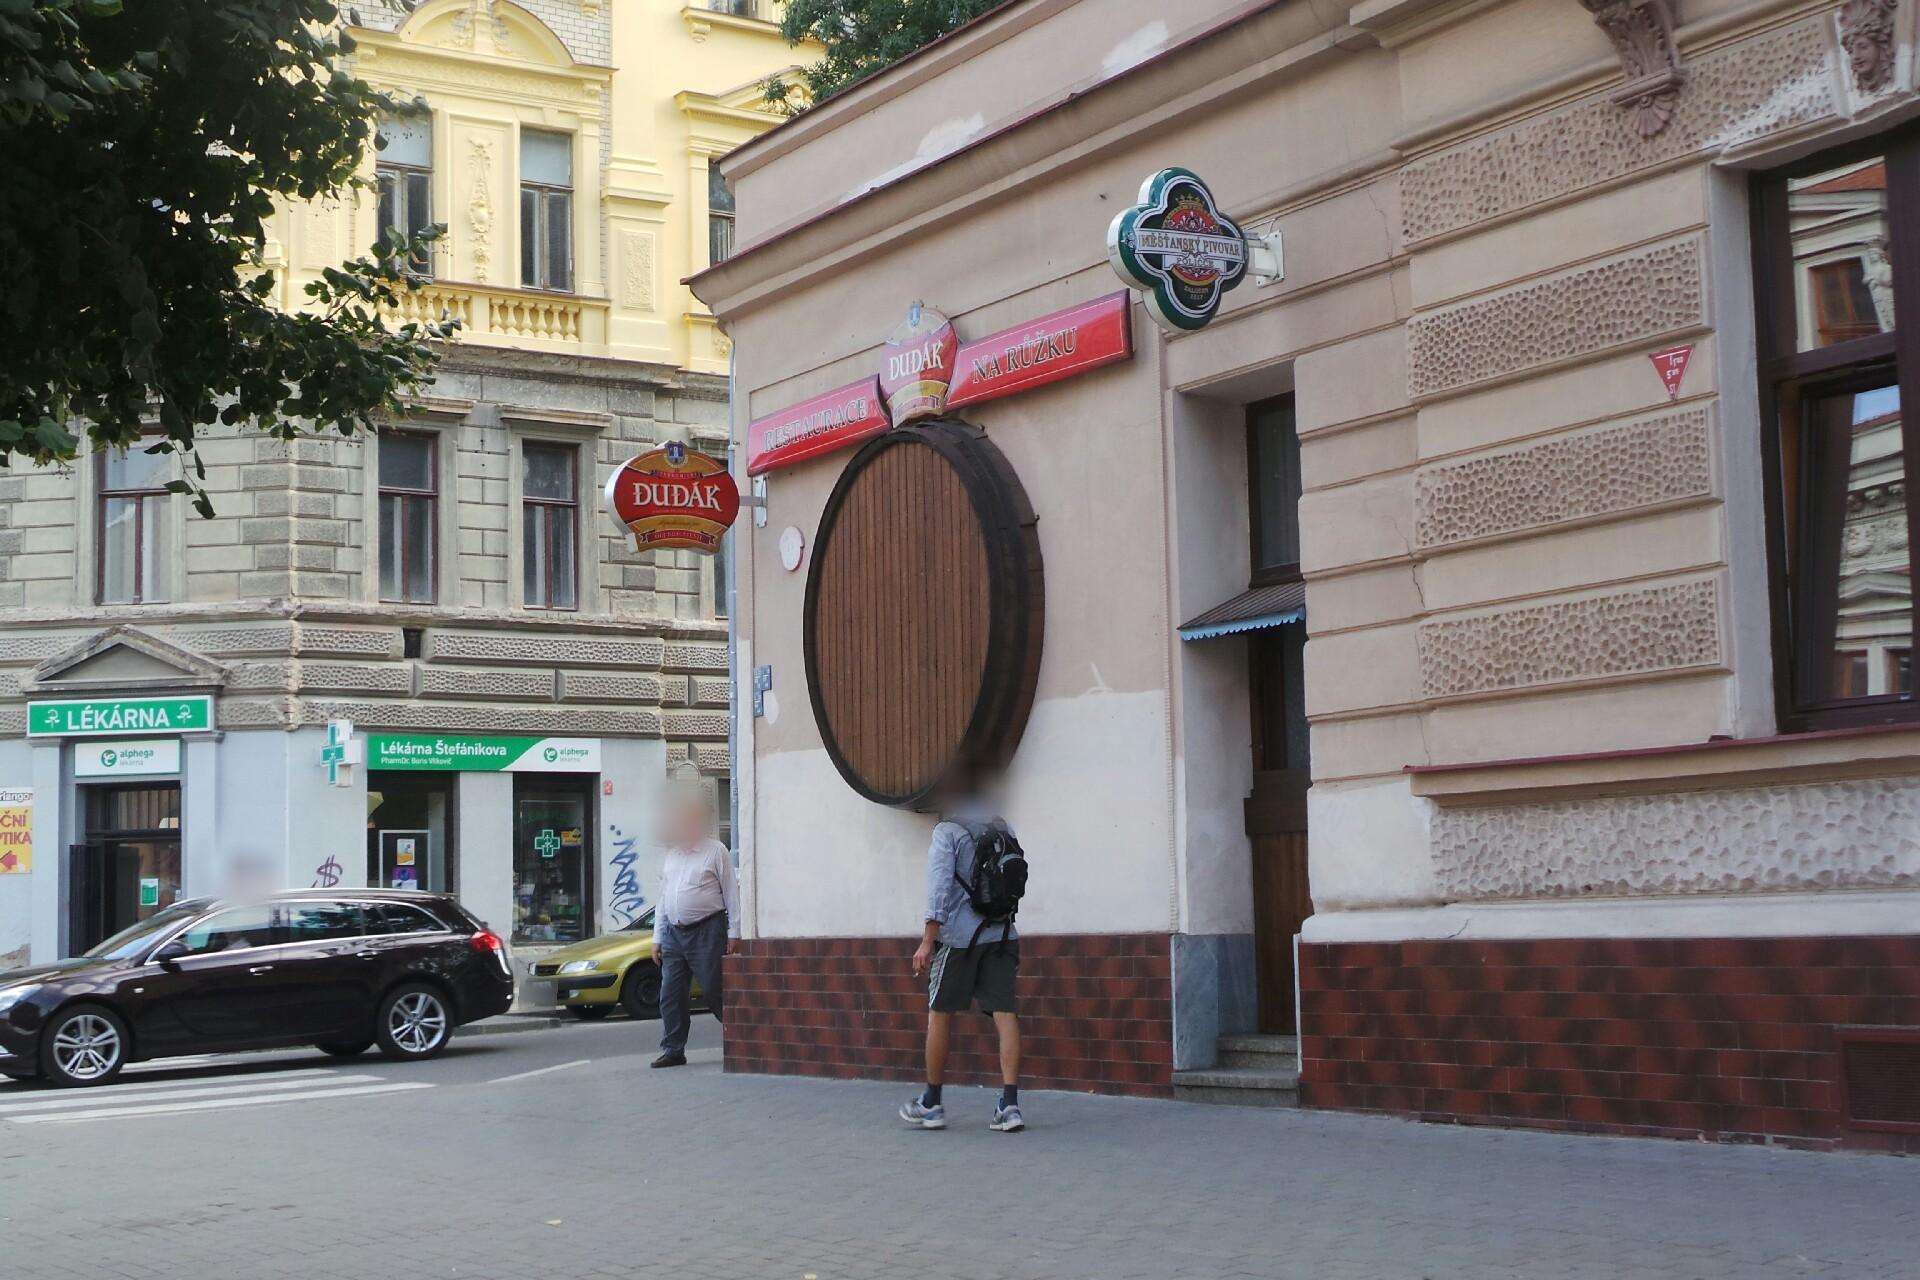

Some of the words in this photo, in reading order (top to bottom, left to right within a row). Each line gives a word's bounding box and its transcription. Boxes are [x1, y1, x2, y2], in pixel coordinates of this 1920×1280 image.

[1141, 233, 1201, 250] MĚŠŤANSKÝ
[1203, 239, 1240, 256] PIVOVAR
[889, 340, 944, 381] DUDÁK
[972, 352, 1003, 384] NA
[1005, 326, 1077, 373] RŮŽKU
[764, 396, 868, 453] RESTAURACE
[632, 481, 723, 512] DUDÁK
[67, 704, 170, 730] LÉKÁRNA
[120, 749, 154, 758] alphega
[381, 741, 432, 755] Lékárna
[435, 740, 507, 755] Štefánikova
[560, 747, 589, 757] alphega
